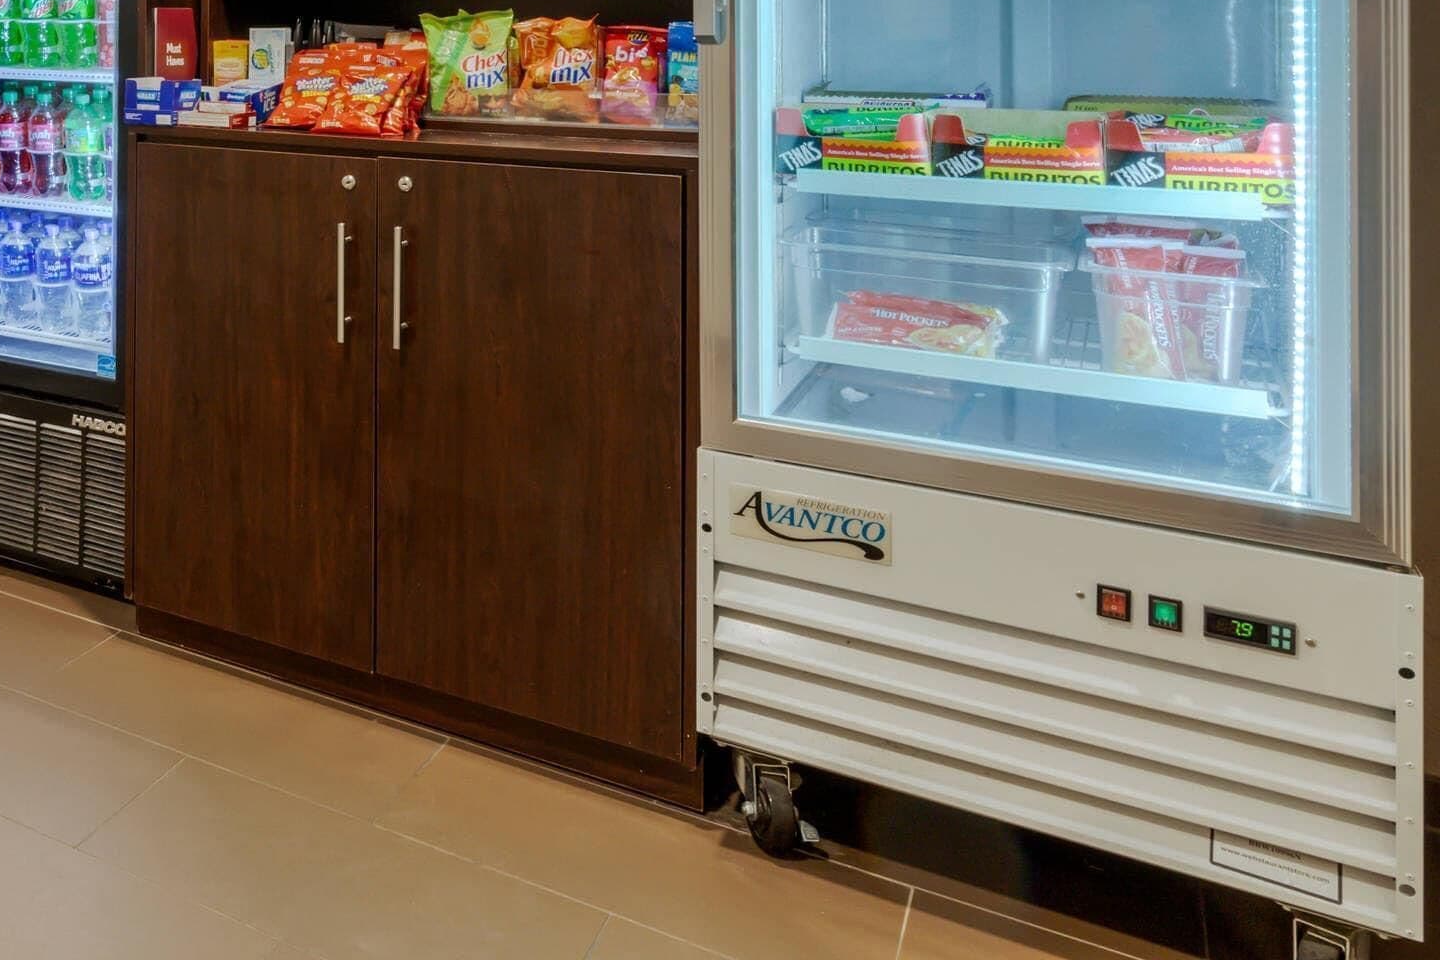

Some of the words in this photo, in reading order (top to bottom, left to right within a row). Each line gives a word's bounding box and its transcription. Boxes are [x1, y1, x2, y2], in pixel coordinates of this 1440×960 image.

[462, 51, 506, 73] Chex
[550, 62, 593, 85] mix
[466, 65, 505, 89] mix
[778, 140, 823, 172] TINA'S
[936, 149, 984, 178] TINA'S
[1110, 155, 1166, 188] TINA'S
[1172, 164, 1207, 173] America's
[1208, 165, 1224, 173] Best
[1225, 166, 1251, 175] Selling
[875, 308, 898, 320] HOT
[899, 311, 950, 328] POCKETS
[71, 413, 127, 437] HABCO
[796, 497, 888, 521] REFRIGERATION
[733, 491, 887, 560] AVANTCO
